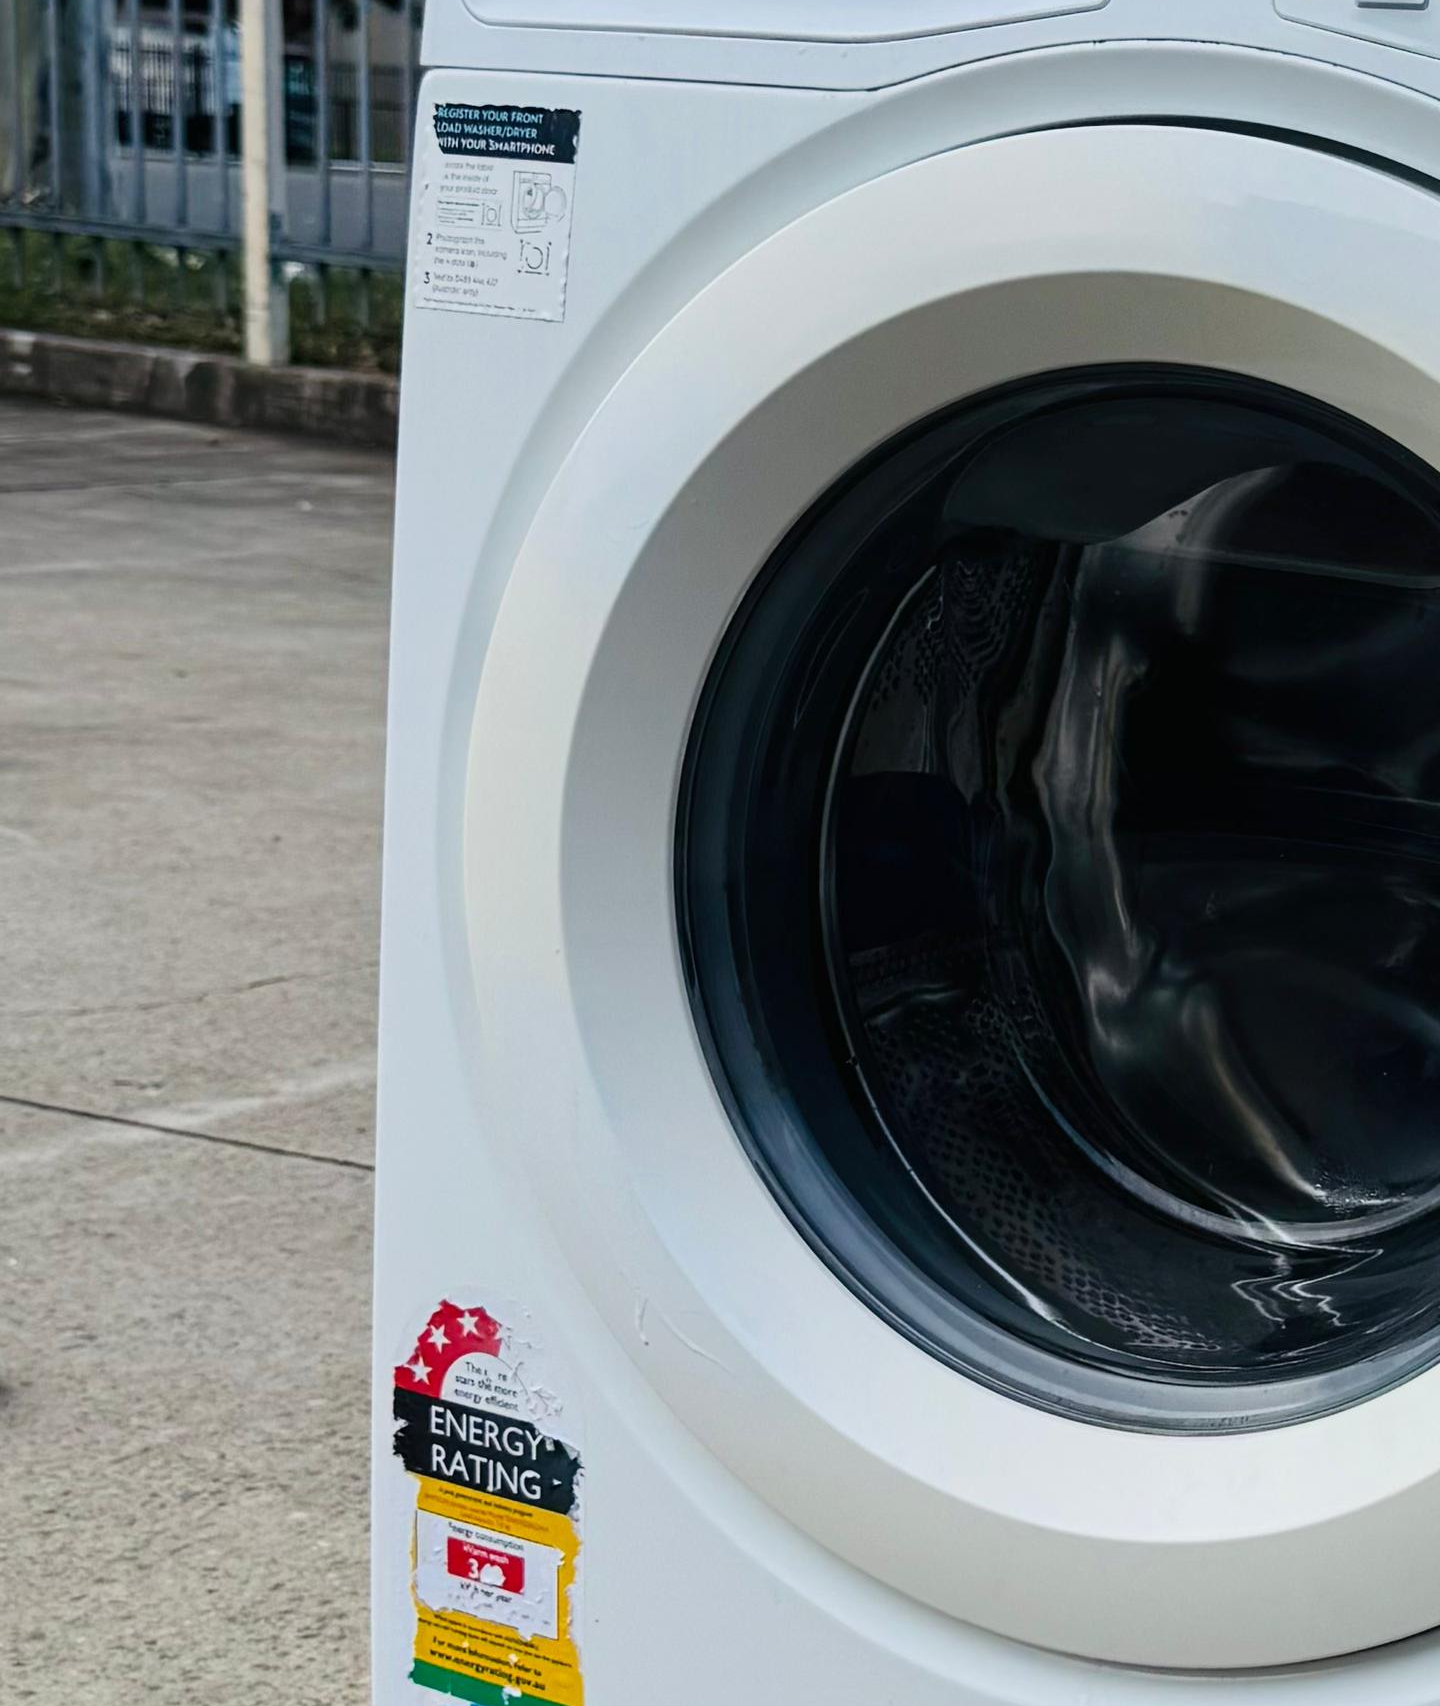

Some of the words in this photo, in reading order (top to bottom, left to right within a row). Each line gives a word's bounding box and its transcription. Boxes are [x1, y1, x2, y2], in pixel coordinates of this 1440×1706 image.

[437, 107, 481, 120] REGISTER
[482, 109, 508, 122] YOUR
[511, 111, 544, 124] FRONT
[437, 121, 462, 134] LOAD
[463, 122, 538, 139] WASHER/DRYER
[461, 137, 487, 150] YOUR
[488, 138, 556, 155] SMARTPHONE
[426, 232, 433, 245] 2
[430, 1404, 545, 1461] ENERGY
[431, 1443, 542, 1501] RATING
